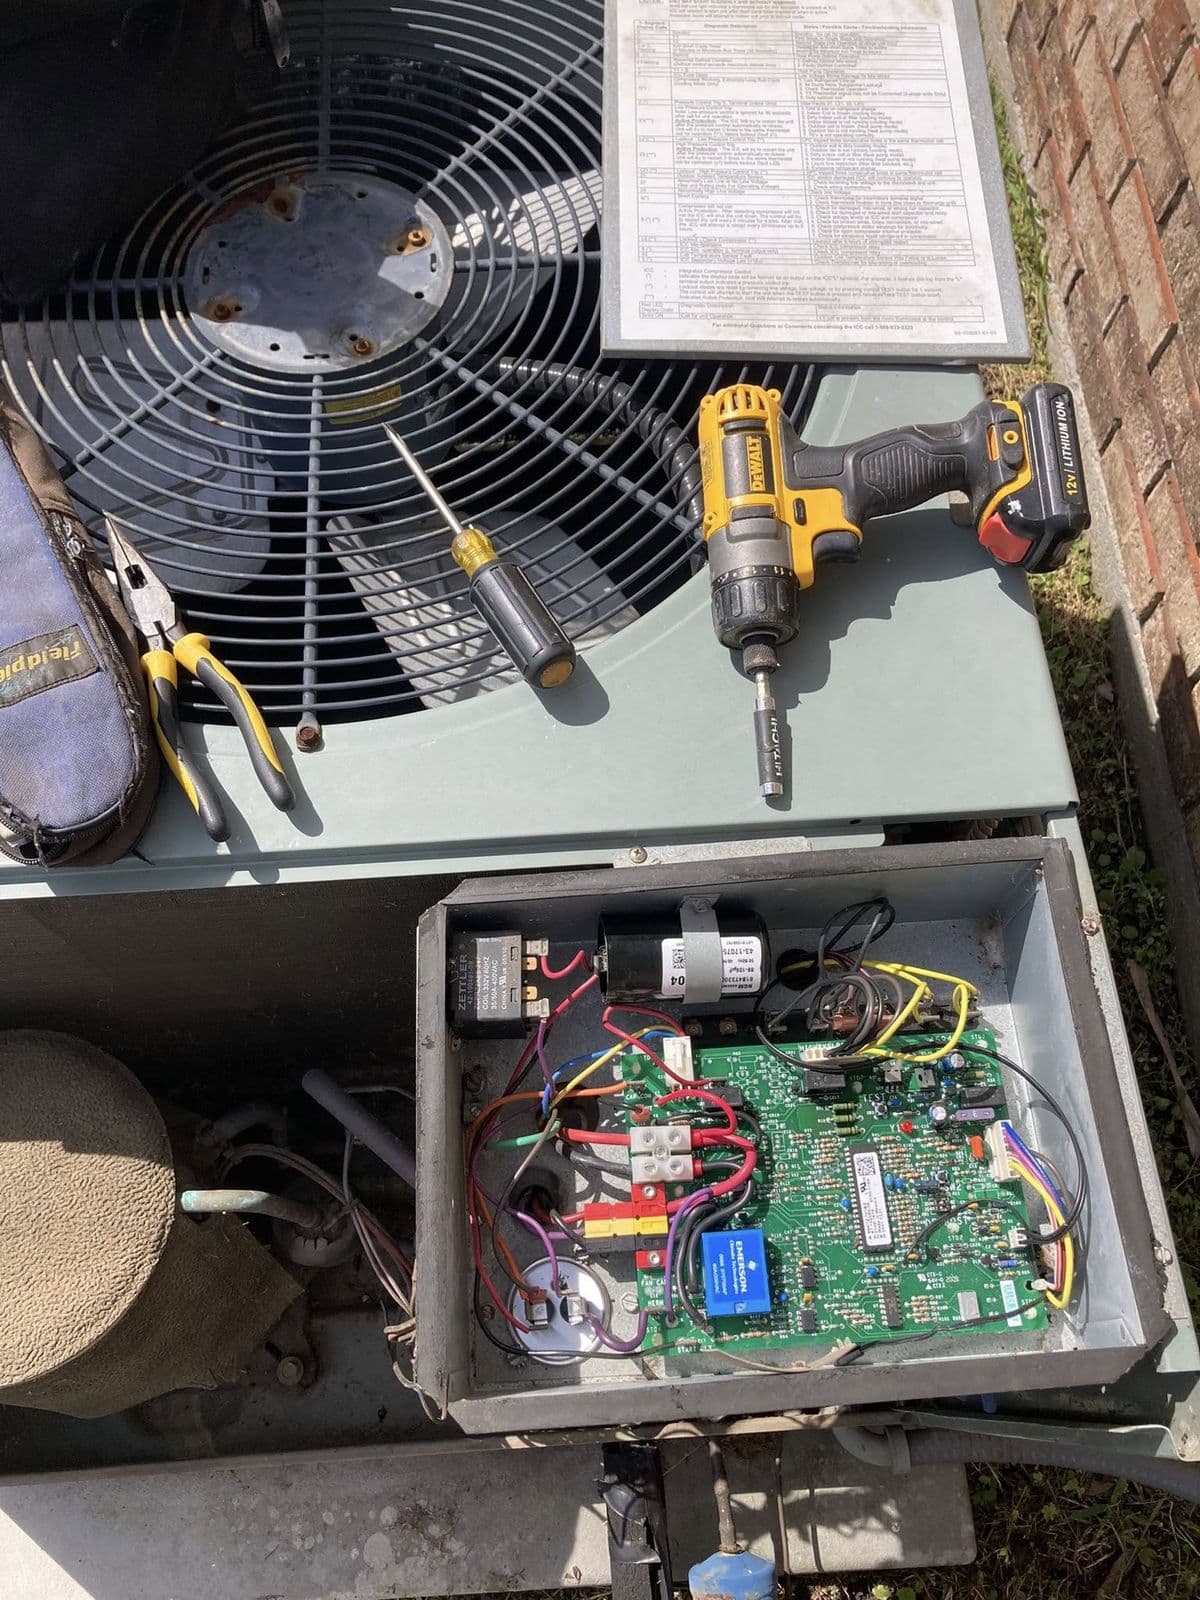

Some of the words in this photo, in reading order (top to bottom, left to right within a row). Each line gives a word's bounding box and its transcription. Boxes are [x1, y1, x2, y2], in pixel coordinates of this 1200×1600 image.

[1056, 401, 1068, 421] ION
[748, 436, 765, 491] DEWALT
[1058, 422, 1074, 466] LITHIUM
[771, 717, 783, 777] HITACHI
[459, 954, 468, 1011] ZETTLER
[671, 976, 685, 986] 04
[863, 1092, 886, 1103] TEST
[736, 1241, 747, 1293] EMERSON
